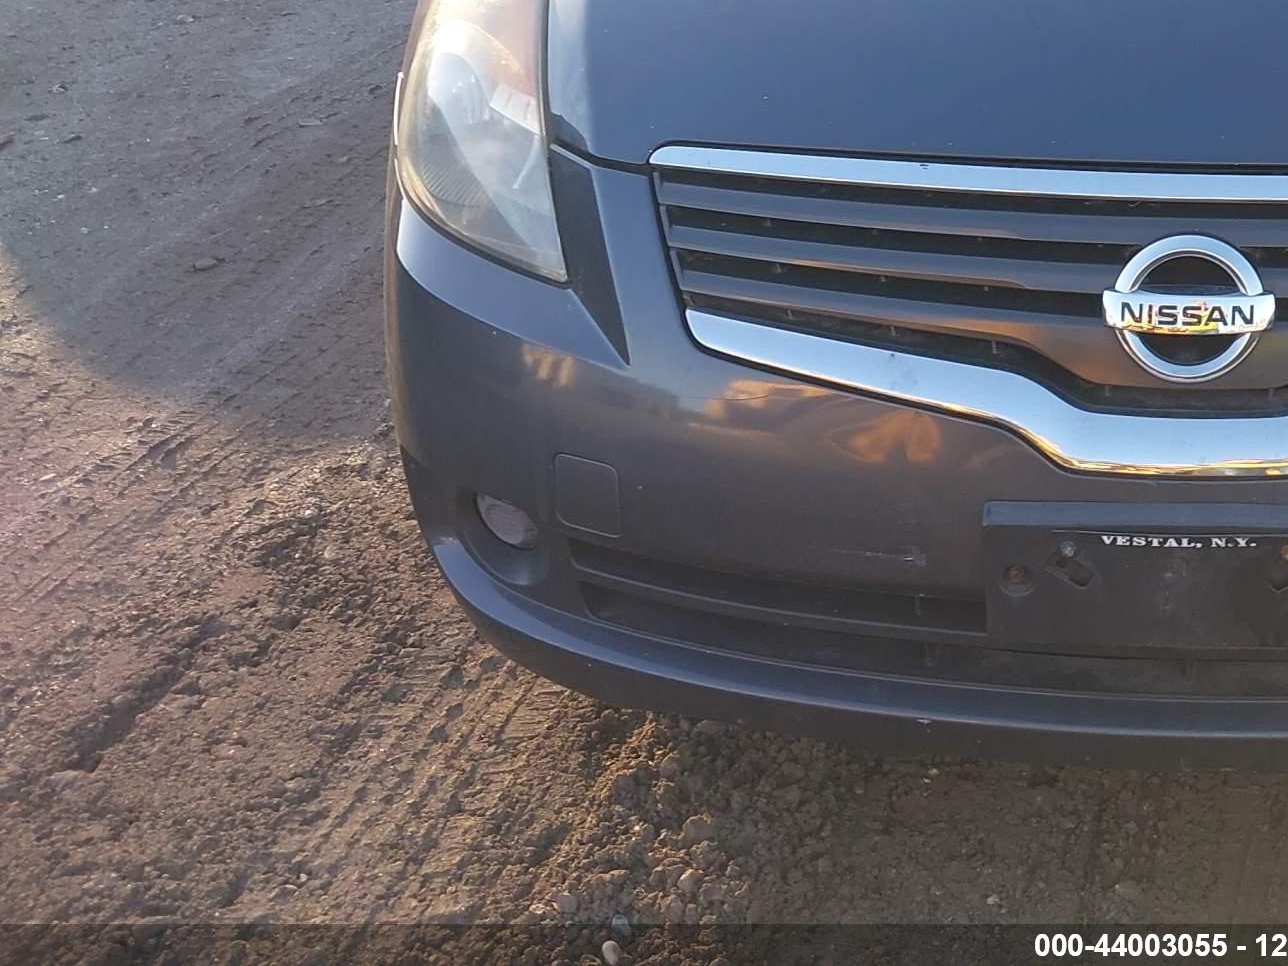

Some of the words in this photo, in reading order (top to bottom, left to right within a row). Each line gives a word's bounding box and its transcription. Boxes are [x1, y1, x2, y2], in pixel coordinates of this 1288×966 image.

[1119, 300, 1255, 327] NISSAN
[1100, 535, 1203, 548] VESTAL,
[1209, 536, 1257, 548] N.Y.
